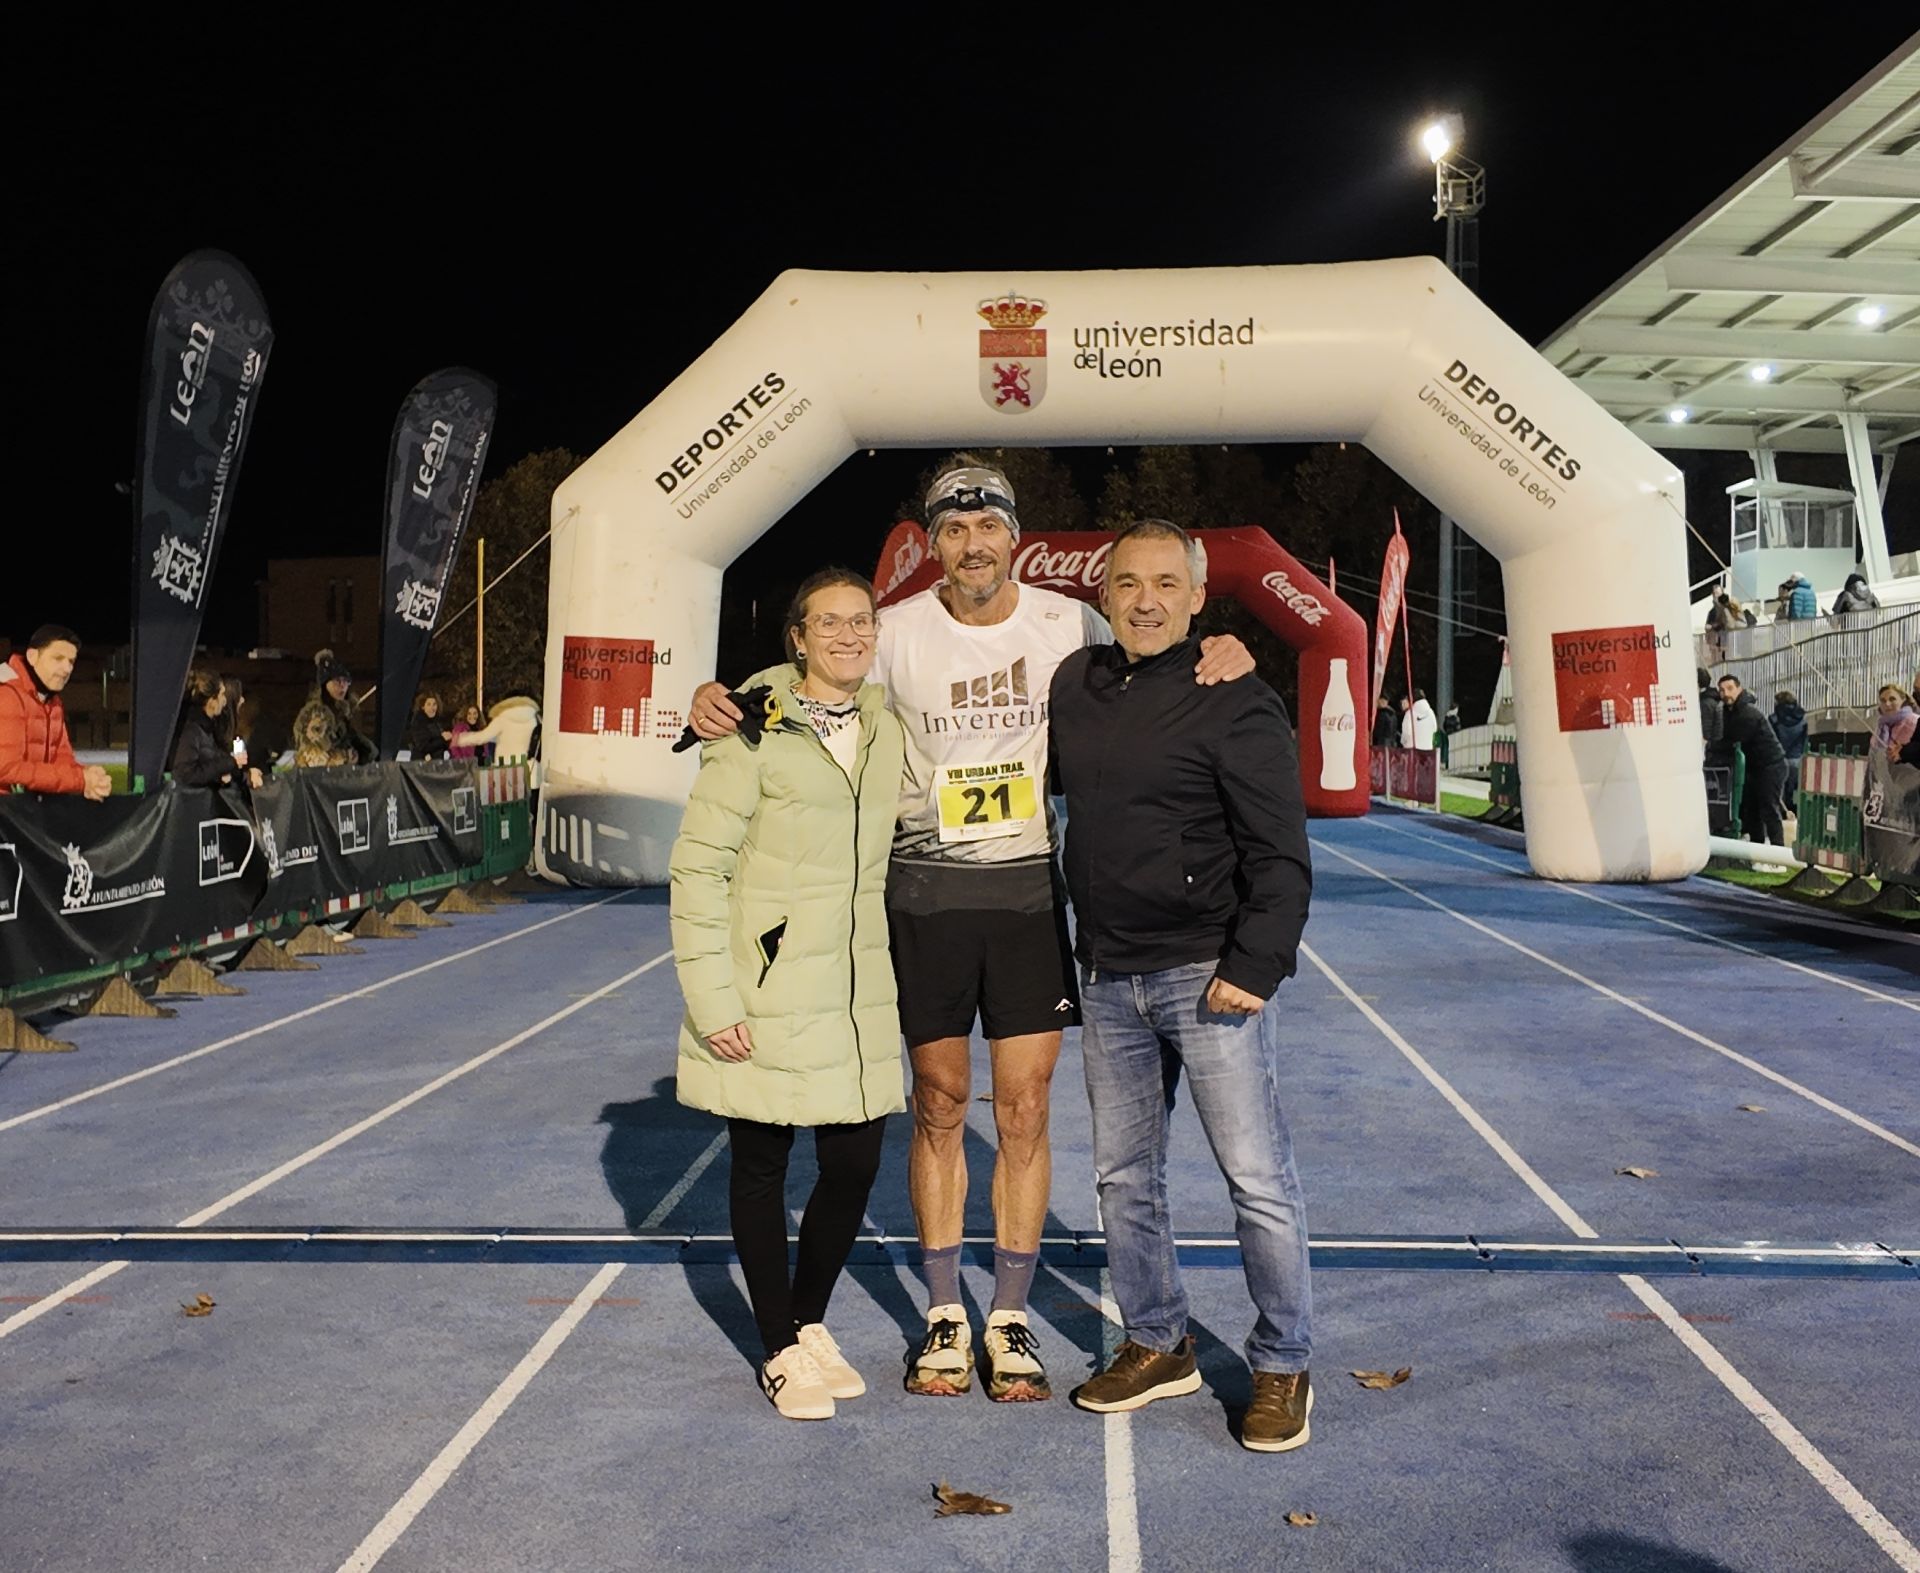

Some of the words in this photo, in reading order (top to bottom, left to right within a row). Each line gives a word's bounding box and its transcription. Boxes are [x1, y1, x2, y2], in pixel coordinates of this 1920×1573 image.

[1074, 317, 1254, 348] universidad
[1074, 348, 1098, 370] de
[1099, 348, 1162, 379] león
[655, 372, 785, 495] DEPORTES
[1443, 359, 1581, 481] DEPORTES
[676, 445, 758, 519] Universidad
[757, 430, 777, 449] de
[773, 397, 813, 432] León
[1418, 385, 1502, 460] Universidad
[1499, 457, 1519, 477] de
[1519, 472, 1557, 510] León
[563, 643, 671, 666] universidad
[1553, 630, 1671, 658] universidad
[573, 660, 611, 681] león
[1570, 655, 1617, 676] león
[965, 765, 998, 778] URBAN
[1000, 761, 1025, 774] TRAIL
[961, 783, 1012, 825] 21
